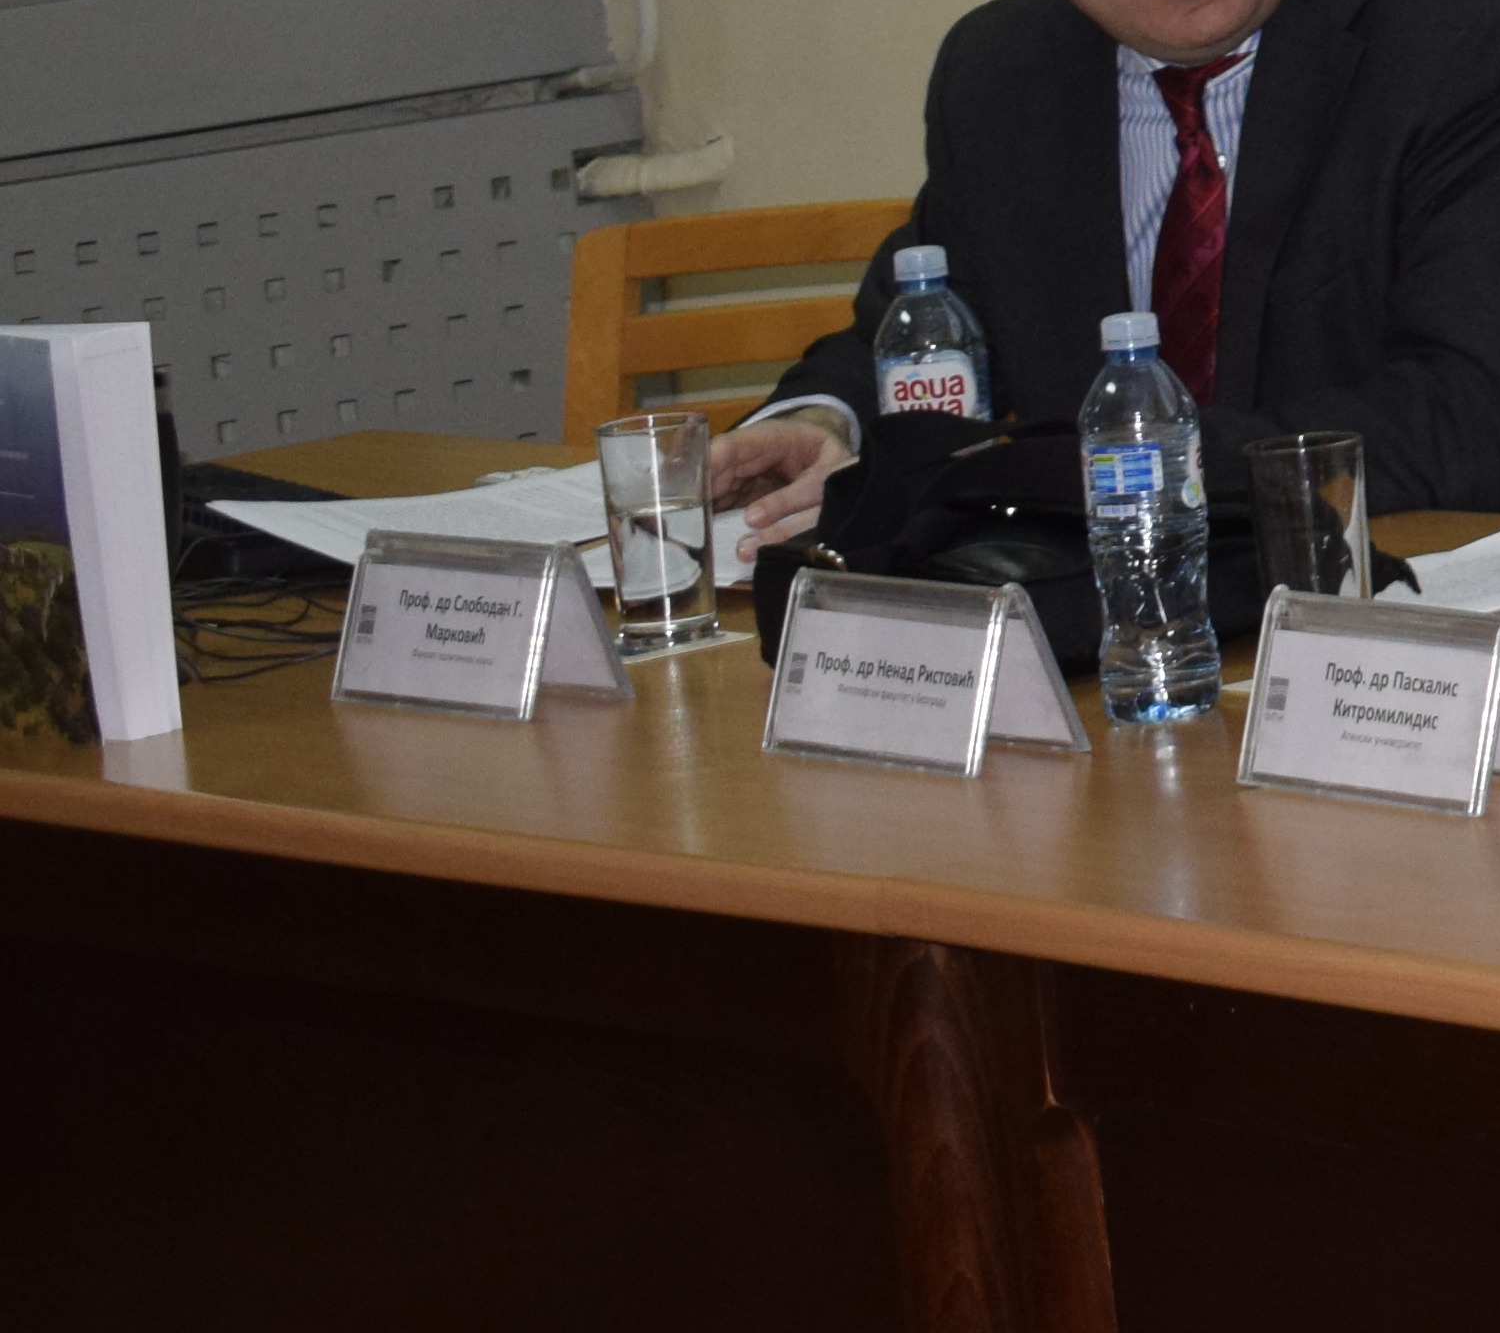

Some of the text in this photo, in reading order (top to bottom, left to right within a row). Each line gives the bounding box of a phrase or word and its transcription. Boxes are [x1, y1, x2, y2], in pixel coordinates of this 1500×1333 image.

[893, 373, 966, 401] aqua
[399, 589, 433, 612] Проф.
[435, 596, 451, 614] др
[453, 595, 511, 619] Слободан
[425, 623, 486, 645] Марковић
[815, 651, 975, 689] Проф. др Ненад Ристовић
[1325, 662, 1459, 698] Проф. др Пасхалис
[1332, 697, 1439, 732] Китромилидис
